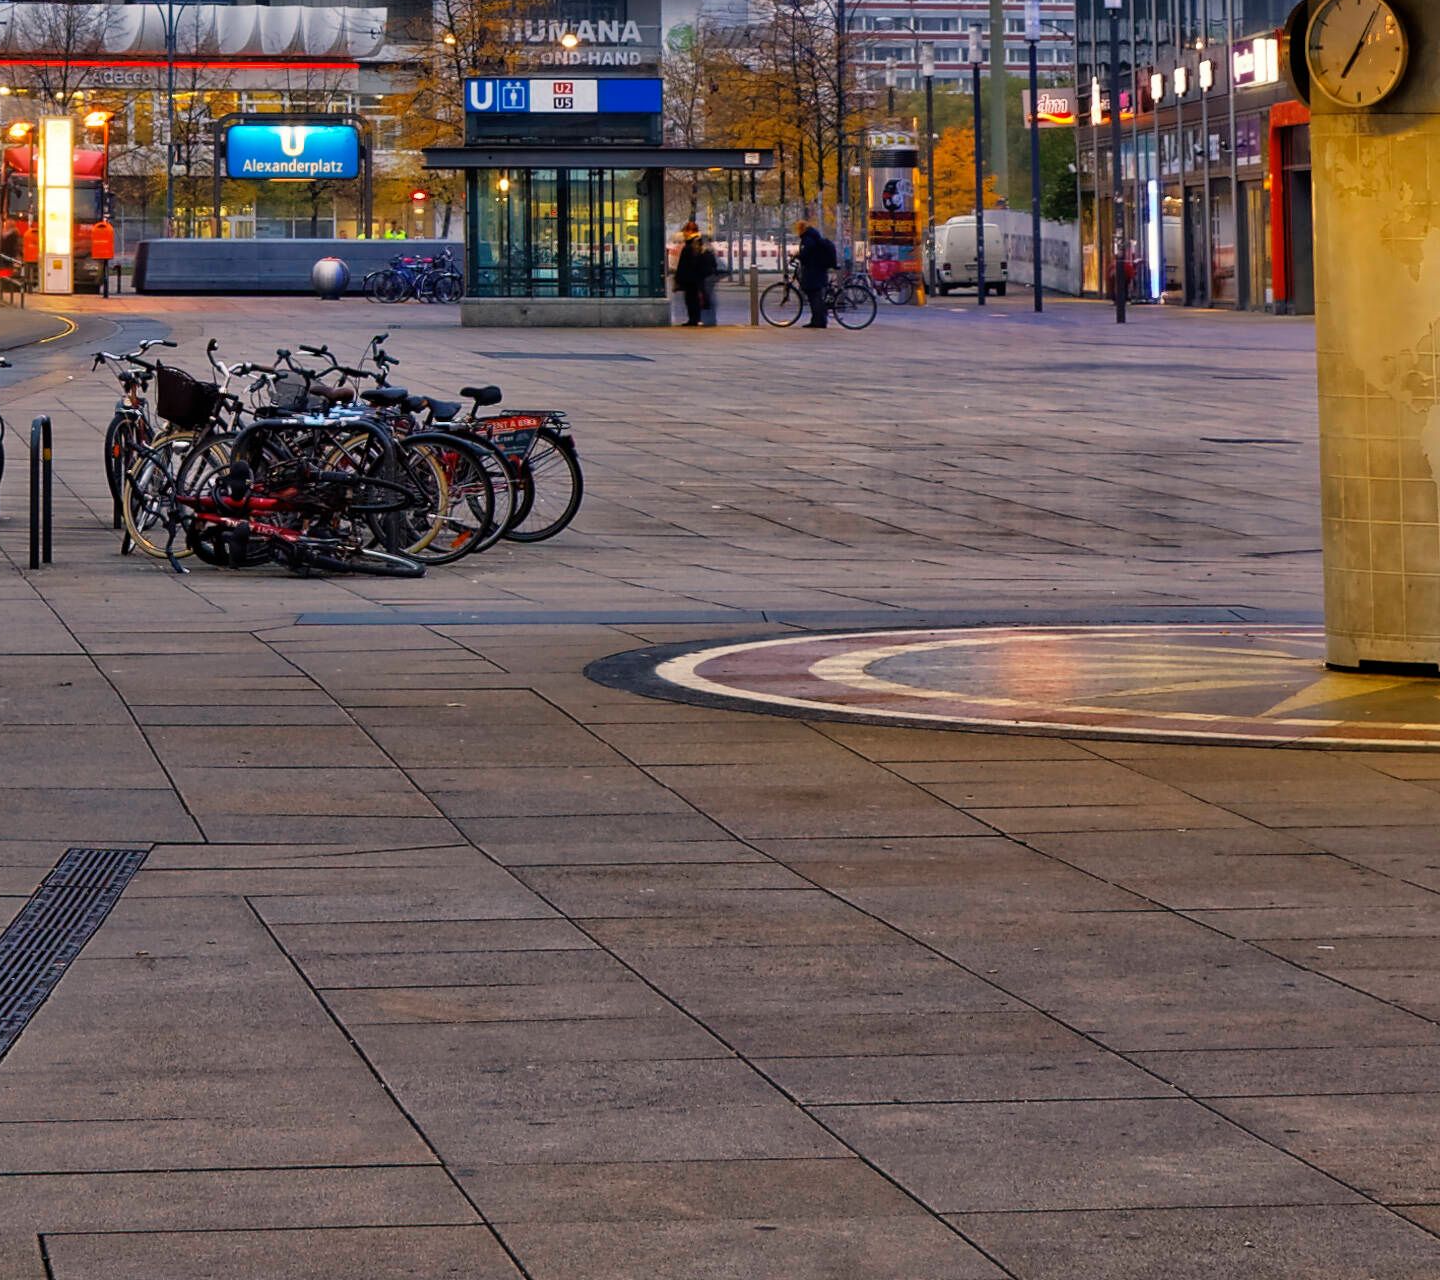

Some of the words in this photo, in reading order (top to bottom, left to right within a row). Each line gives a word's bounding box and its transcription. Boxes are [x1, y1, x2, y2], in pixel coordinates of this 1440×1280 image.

[91, 69, 152, 85] Adecco
[470, 81, 493, 110] U
[554, 83, 572, 94] U2
[554, 98, 572, 109] U5
[1037, 93, 1069, 114] dm
[281, 126, 305, 157] U
[242, 158, 344, 176] Alexanderplatz
